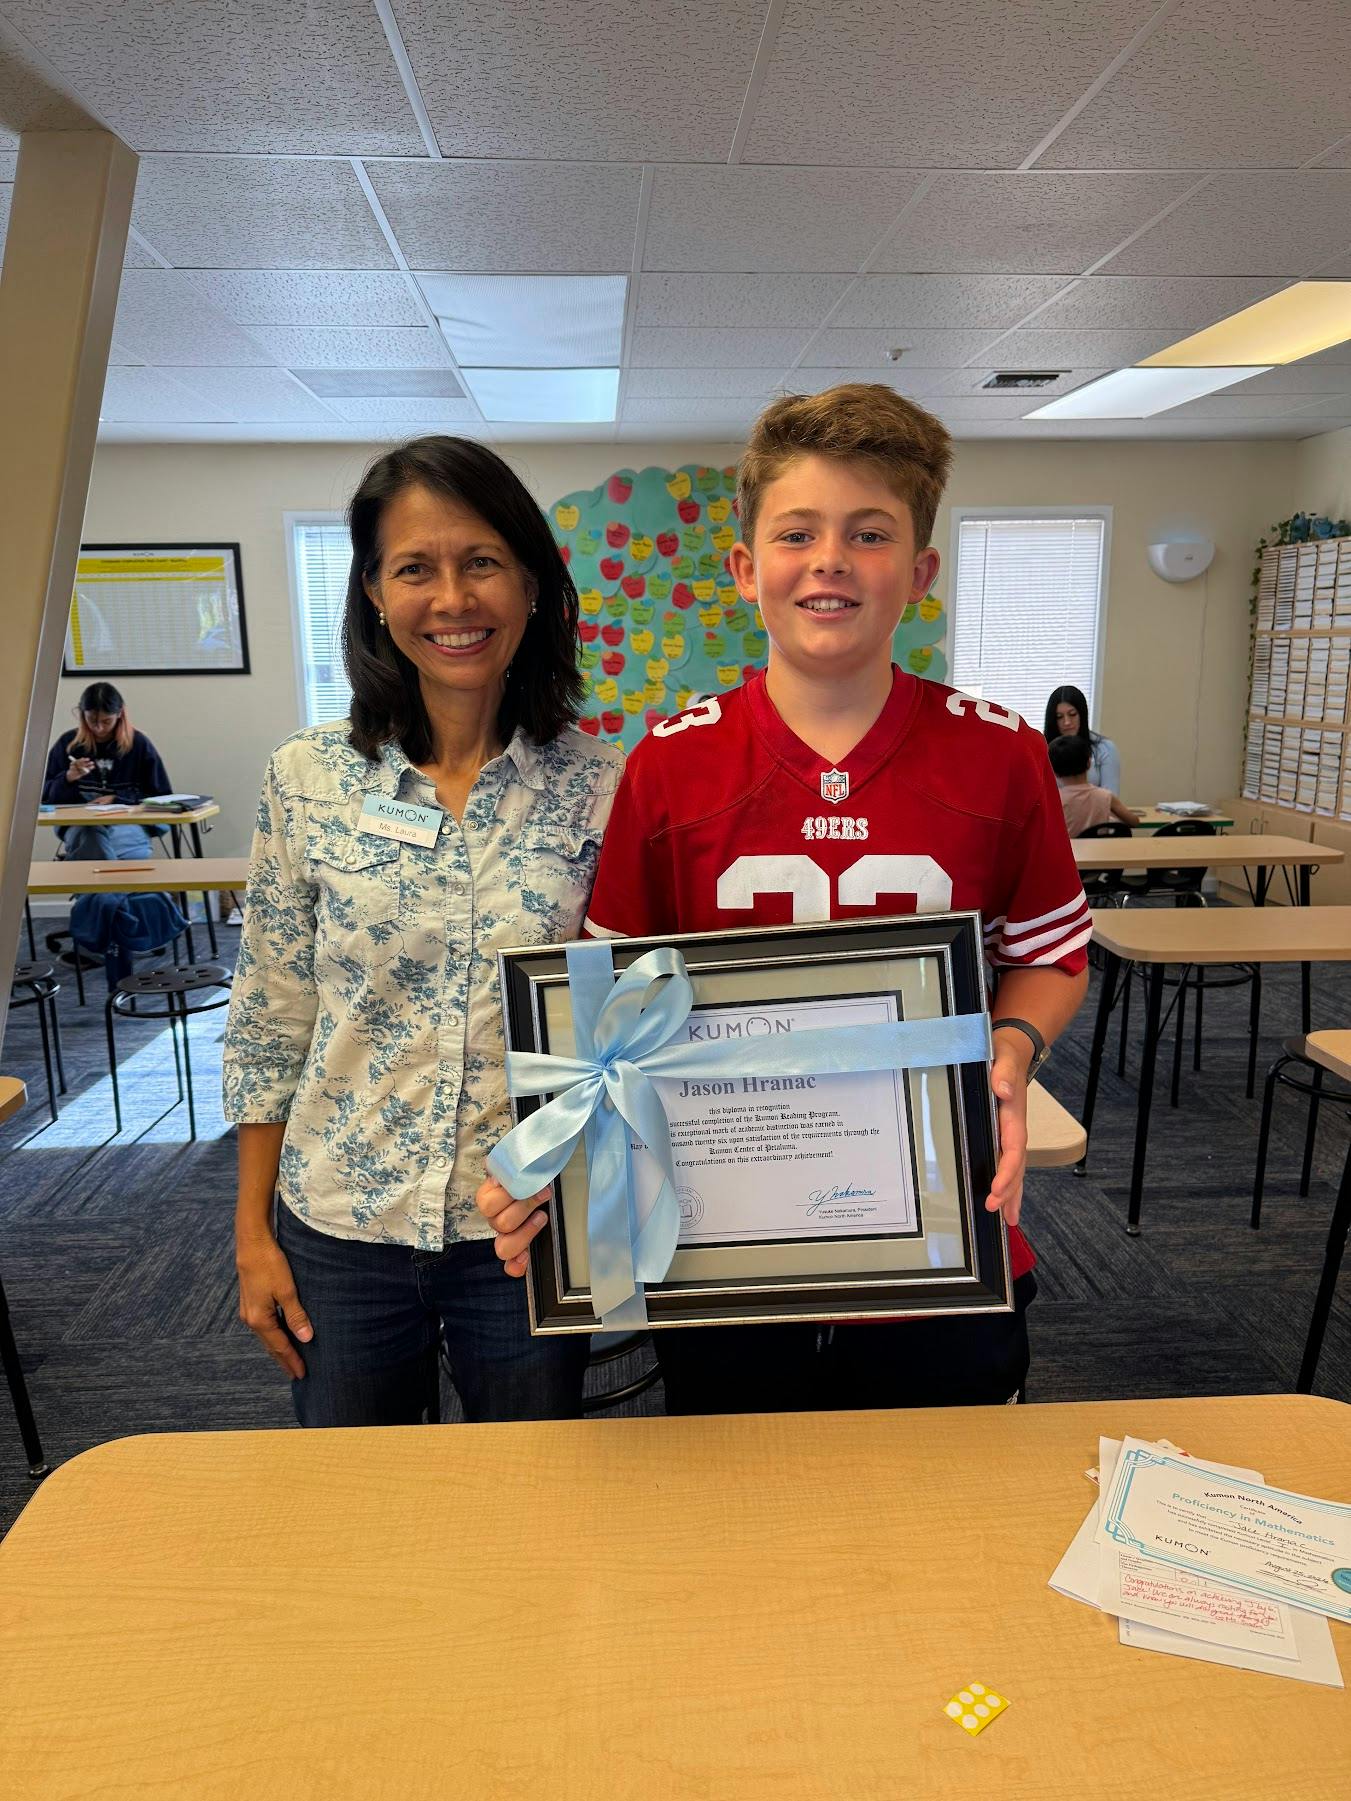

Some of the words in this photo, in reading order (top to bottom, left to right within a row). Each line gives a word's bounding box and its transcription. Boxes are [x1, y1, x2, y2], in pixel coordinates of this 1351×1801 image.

[825, 784, 845, 797] NFL
[378, 804, 427, 823] KUMON
[379, 822, 393, 834] Ms.
[395, 826, 417, 838] Laura
[801, 816, 869, 840] 49ERS
[688, 1016, 792, 1042] KUMON
[679, 1080, 735, 1098] Jason
[742, 1076, 817, 1094] Hranac
[756, 1103, 791, 1112] recognition
[702, 1117, 734, 1126] completion
[755, 1114, 779, 1122] Kumon
[781, 1112, 807, 1120] Reading
[677, 1128, 711, 1137] exceptional
[738, 1125, 765, 1133] academic
[766, 1122, 799, 1131] distinction
[815, 1120, 835, 1128] earned
[746, 1134, 781, 1142] satisfaction
[783, 1132, 789, 1140] of
[790, 1132, 800, 1140] the
[802, 1130, 842, 1139] requirements
[844, 1128, 869, 1137] through
[870, 1127, 880, 1135] the
[676, 1158, 726, 1167] Congratulations
[750, 1153, 793, 1163] extraordinary
[794, 1151, 833, 1160] achievement!
[1237, 1495, 1265, 1506] North
[1268, 1504, 1303, 1525] America
[1172, 1493, 1237, 1519] Proficiency
[1240, 1513, 1251, 1522] in
[1255, 1518, 1335, 1546] Mathematics
[1155, 1535, 1209, 1556] KUMON
